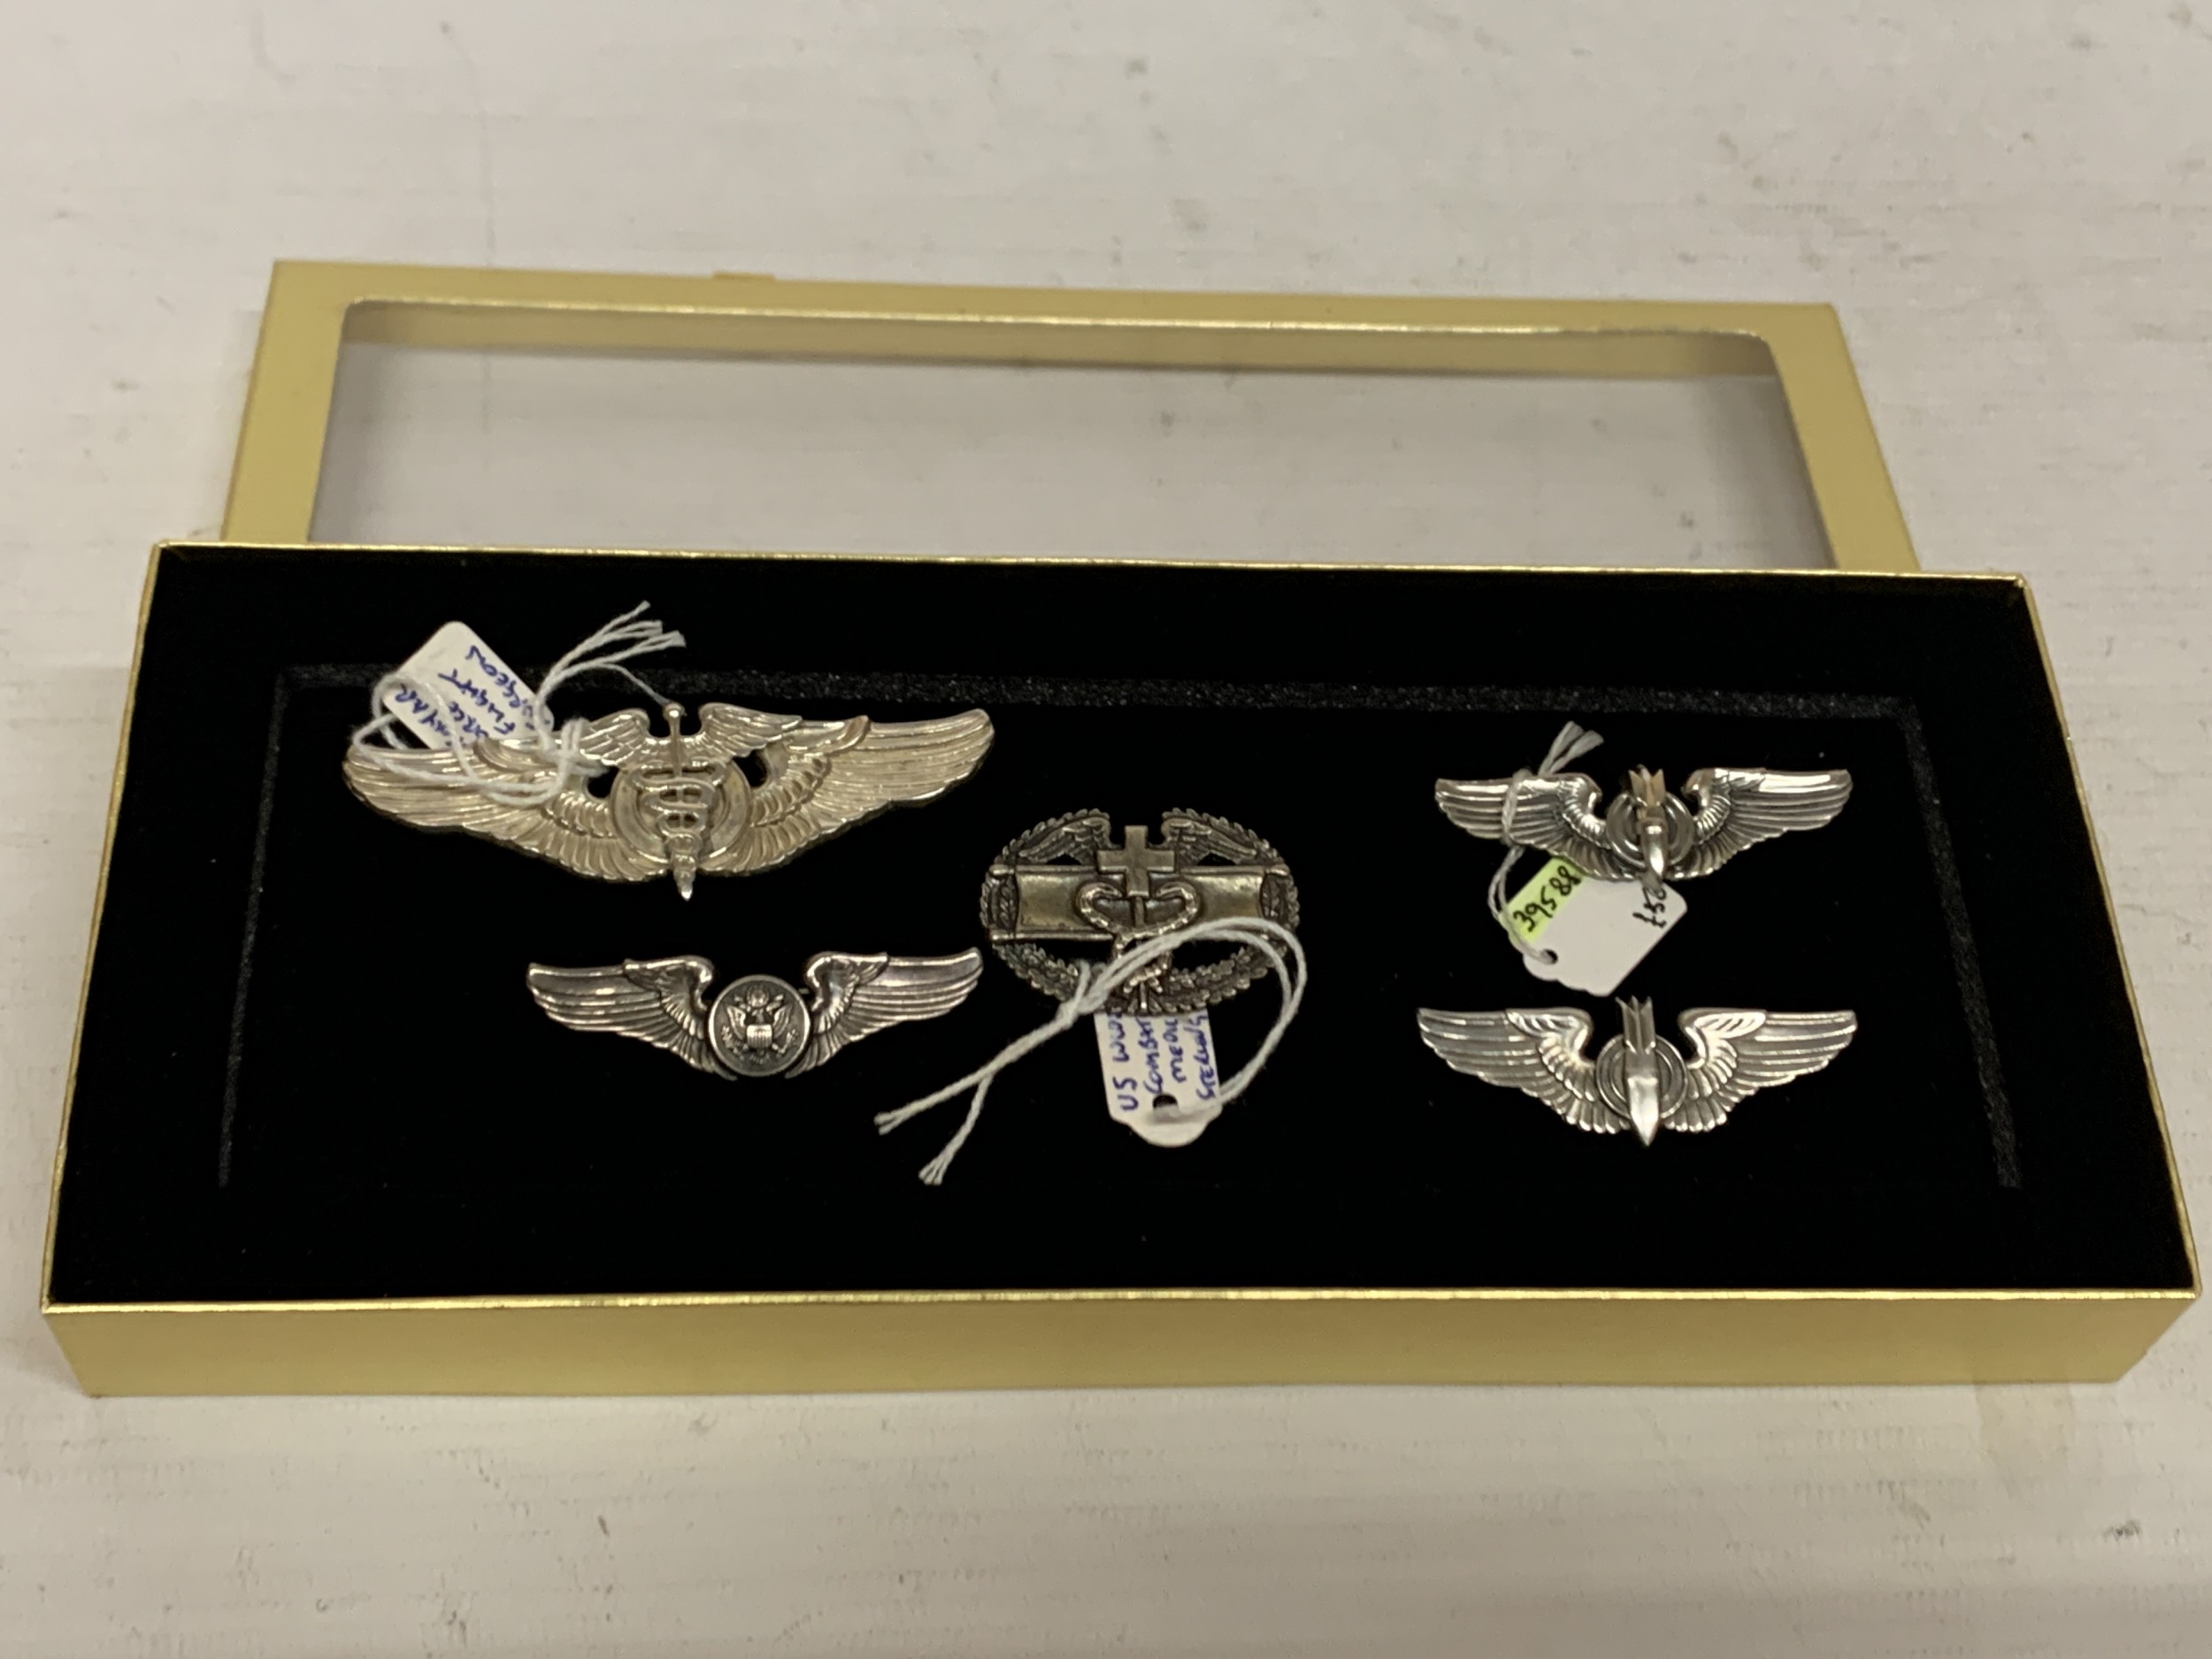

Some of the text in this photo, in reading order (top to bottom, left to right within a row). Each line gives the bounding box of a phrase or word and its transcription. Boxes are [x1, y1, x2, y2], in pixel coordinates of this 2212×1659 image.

[437, 668, 516, 735] FLIGHT
[447, 700, 489, 738] ORCE
[1512, 864, 1583, 933] 39588
[1112, 1076, 1139, 1111] US
